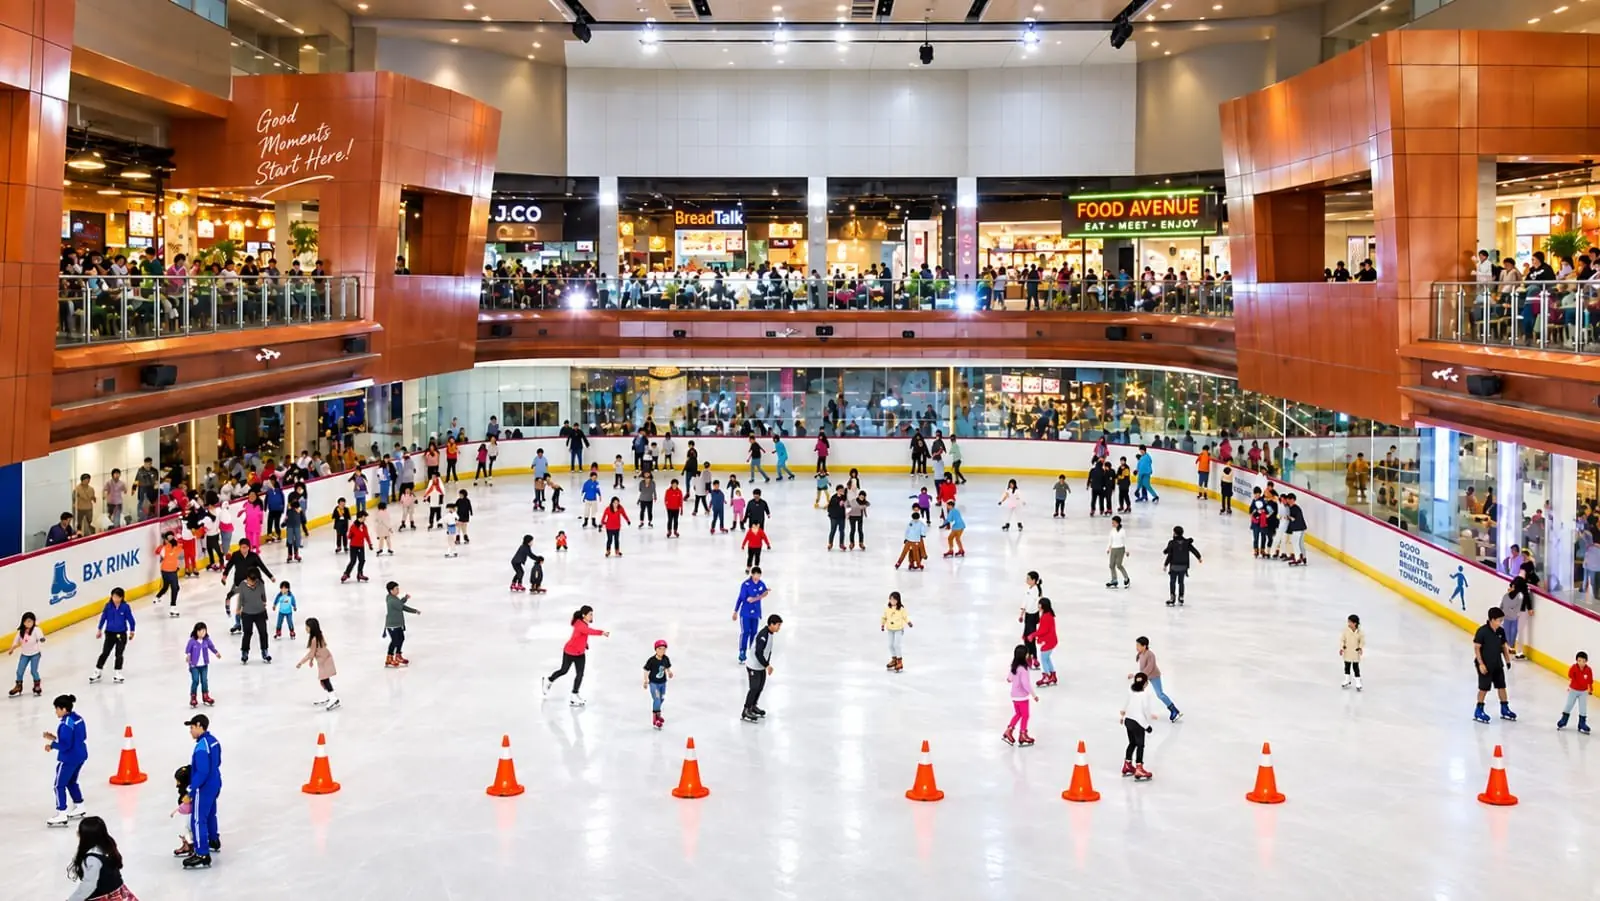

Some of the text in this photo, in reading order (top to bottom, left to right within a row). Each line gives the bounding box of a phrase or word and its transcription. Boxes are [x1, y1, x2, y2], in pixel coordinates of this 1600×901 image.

[257, 102, 299, 133] Good
[258, 122, 331, 159] Moments
[255, 138, 354, 185] Start Here!
[675, 210, 744, 225] BreadTalk
[1077, 197, 1199, 218] FOOD AVENUE
[1084, 219, 1198, 231] EAT MEET ENJOY
[83, 548, 140, 582] BX RINK
